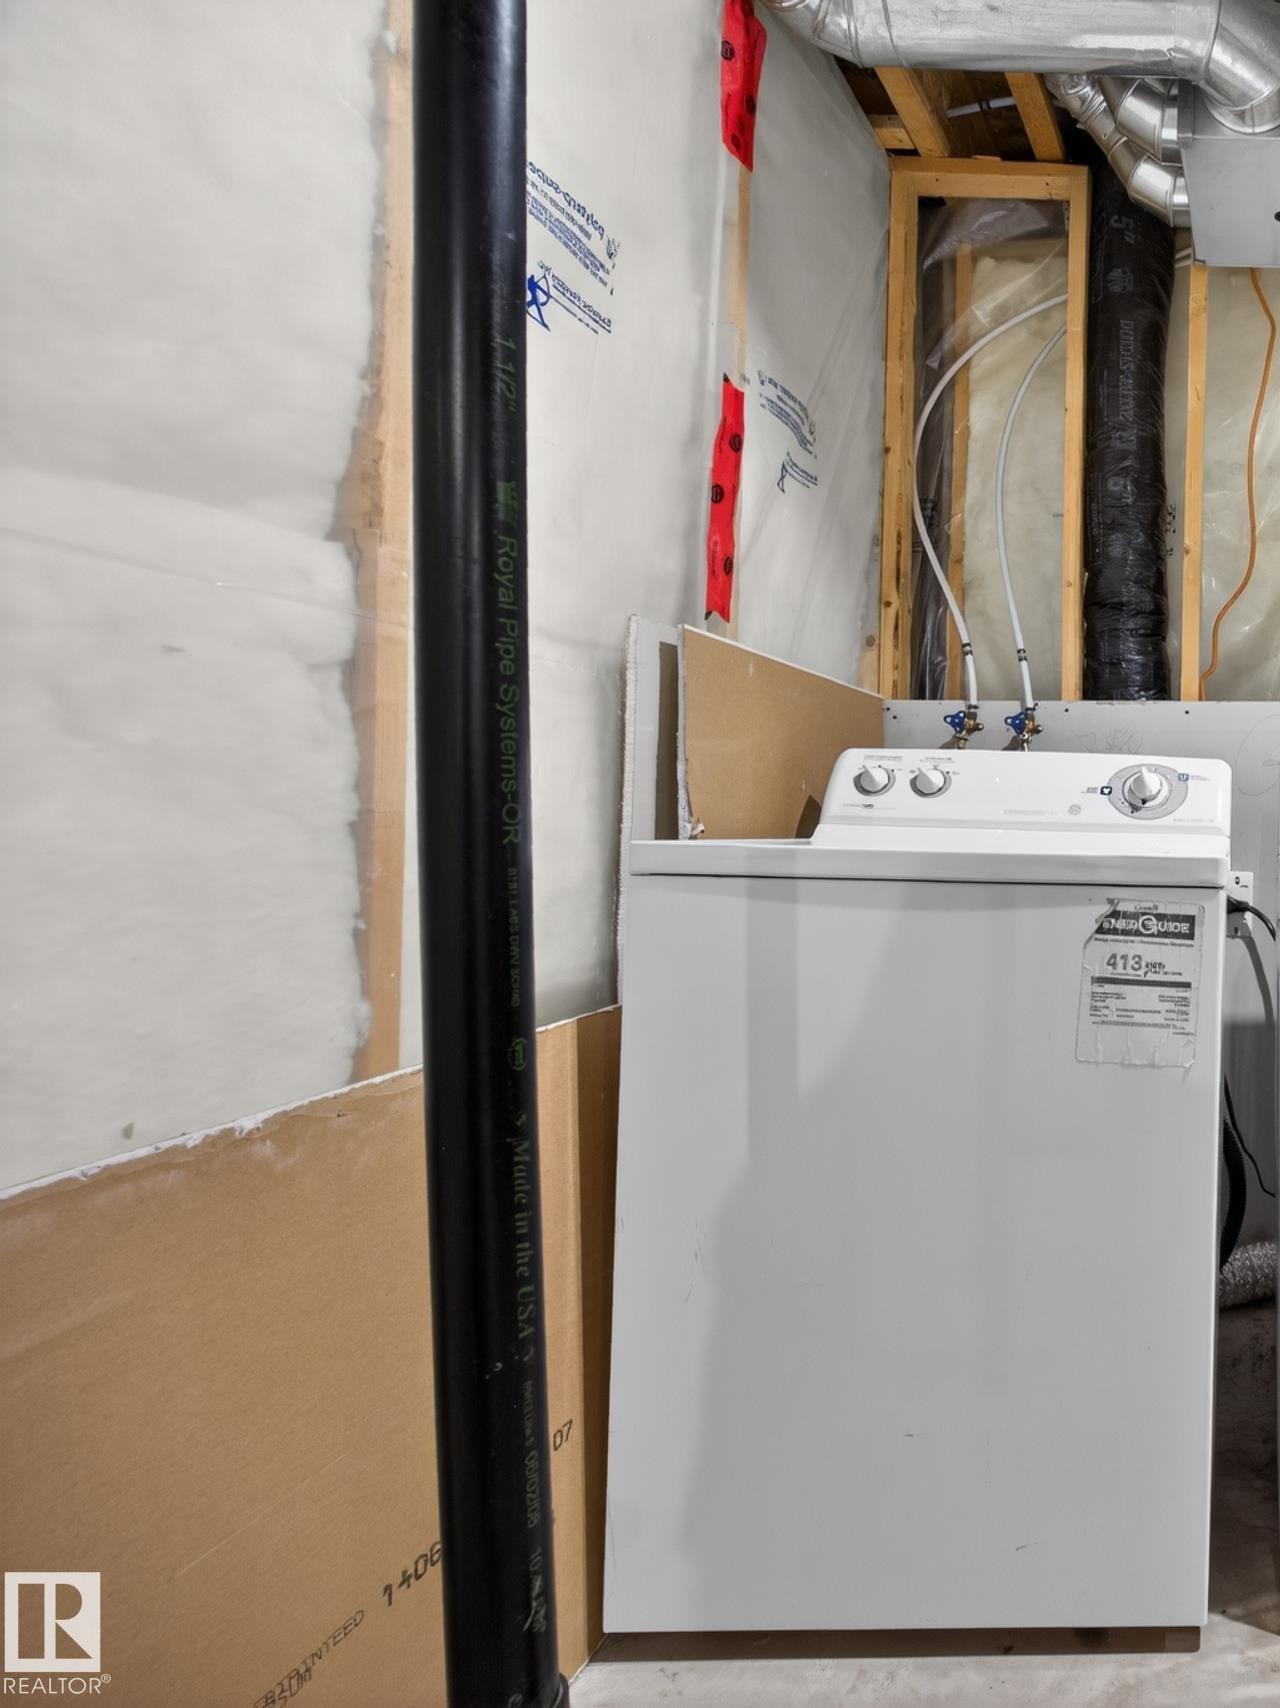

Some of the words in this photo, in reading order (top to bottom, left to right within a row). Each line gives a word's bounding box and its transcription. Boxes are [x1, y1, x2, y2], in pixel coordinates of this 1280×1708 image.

[494, 535, 518, 609] Royal
[494, 617, 519, 675] Pipe
[496, 683, 522, 845] Systems-OR
[1106, 952, 1143, 972] 413
[512, 1138, 533, 1205] Made
[514, 1211, 533, 1235] in
[515, 1241, 534, 1278] the
[516, 1284, 536, 1339] USA
